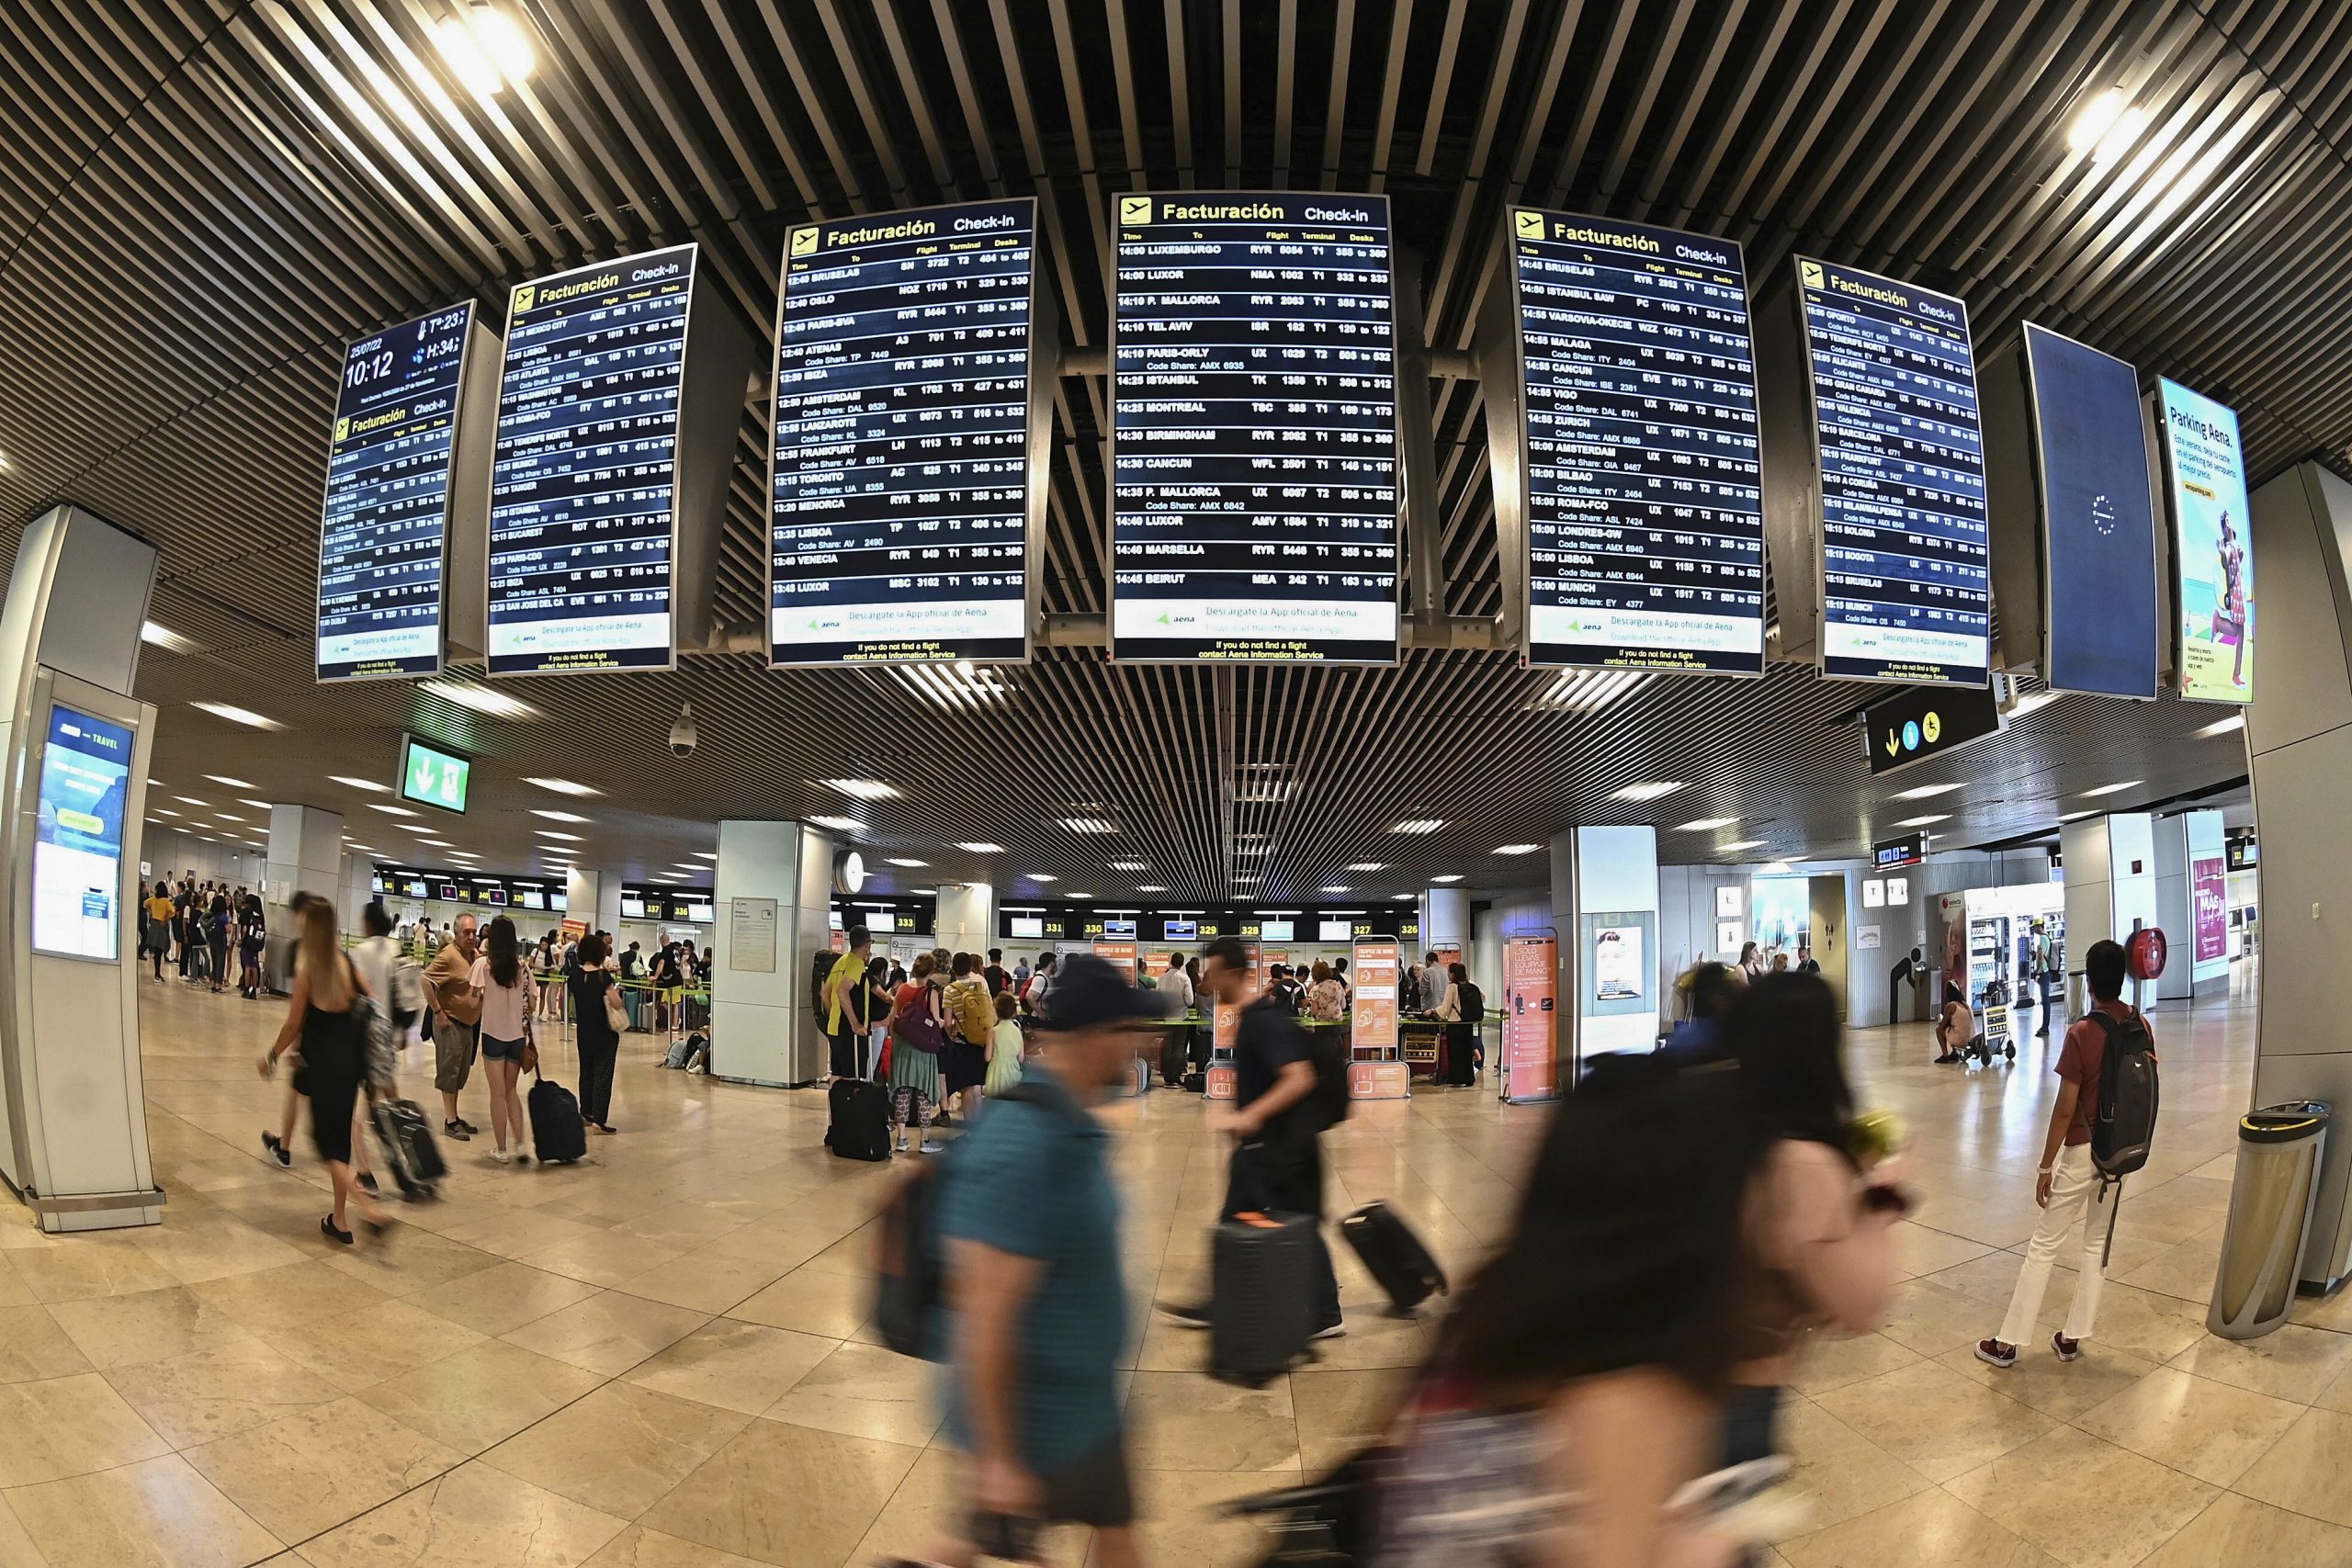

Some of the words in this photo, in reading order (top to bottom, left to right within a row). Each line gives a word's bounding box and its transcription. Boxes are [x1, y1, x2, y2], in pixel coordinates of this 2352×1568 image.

[1164, 204, 1283, 219] Facturación
[1305, 208, 1368, 221] Check-in
[828, 220, 935, 246] Facturación
[954, 215, 1014, 231] Check-in
[1266, 231, 1289, 240] Flight
[916, 246, 937, 254] Flight
[949, 242, 981, 250] Terminal
[1555, 223, 1659, 253] Facturación
[1676, 245, 1726, 265] Check-in
[1119, 246, 1145, 255] 14:00
[1148, 245, 1221, 254] LUXEMBURGO
[1250, 245, 1272, 254] RYR
[1312, 246, 1324, 255] T1
[1519, 259, 1543, 269] 14:45
[1545, 263, 1595, 276] BRUSELAS
[1521, 246, 1538, 254] Time
[1646, 264, 1665, 272] Flight
[1675, 268, 1702, 278] Terminal
[1713, 275, 1733, 284] Desks
[811, 268, 860, 282] BRUSELAS
[1119, 271, 1145, 280] 14:00
[1148, 270, 1183, 279] LUXOR
[1313, 271, 1324, 280] T1
[540, 275, 618, 303] Facturación
[632, 264, 678, 281] Check-in
[1547, 287, 1592, 300] ISTANBUL
[1594, 292, 1614, 302] SAW
[1830, 275, 1907, 308] Facturación
[1919, 302, 1955, 321] Check-in
[809, 295, 835, 306] OSLO
[1148, 296, 1156, 305] P.
[1161, 296, 1220, 305] MALLORCA
[1147, 321, 1167, 332] TEL
[1168, 321, 1193, 332] AVIV
[1339, 324, 1356, 333] 120
[1373, 325, 1390, 335] 122
[1549, 311, 1633, 330] VARSOVIA-OKECIE
[1664, 327, 1682, 337] 1472
[806, 343, 842, 355] ATENAS
[1010, 327, 1025, 336] 411
[1551, 337, 1591, 349] MALAGA
[350, 338, 382, 358] 25/07/22
[1147, 348, 1209, 357] PARIS-ORLY
[1251, 348, 1267, 357] UX
[1315, 349, 1328, 359] T2
[1619, 357, 1635, 367] 2404
[347, 351, 393, 388] 10:12
[521, 367, 549, 379] ATLANTA
[1552, 363, 1592, 375] CANCUN
[1147, 375, 1199, 385] ISTANBUL
[1374, 378, 1391, 389] 312
[802, 391, 861, 405] AMSTERDAM
[1007, 379, 1023, 389] 431
[1554, 389, 1577, 400] VIGO
[1147, 402, 1206, 412] MONTREAL
[1838, 405, 1871, 417] VALENCIA
[352, 408, 405, 434] Facturación
[414, 399, 447, 415] Check-in
[1622, 410, 1638, 418] 6741
[1555, 416, 1590, 427] ZURICH
[2170, 406, 2207, 440] Parking
[2209, 423, 2233, 448] Aena.
[1147, 430, 1216, 440] BIRMINGHAM
[1838, 429, 1882, 442] BARCELONA
[800, 445, 856, 457] FRANKFURT
[891, 441, 905, 450] LH
[921, 438, 941, 448] 1113
[1146, 458, 1192, 468] CANCUN
[1251, 458, 1275, 468] WFL
[799, 472, 844, 484] TORONTO
[1557, 470, 1593, 481] BILBAO
[1116, 488, 1143, 497] 14:35
[1160, 487, 1221, 496] MALLORCA
[1252, 488, 1268, 497] UX
[1317, 489, 1329, 498] T2
[798, 499, 845, 511] MENORCA
[1557, 498, 1609, 510] ROMA-FCO
[1146, 516, 1183, 525] LUXOR
[1252, 516, 1277, 525] AMV
[1376, 519, 1393, 528] 321
[1625, 517, 1643, 525] 7424
[1558, 525, 1622, 538] LONDRES-GW
[1146, 545, 1204, 554] MARSELLA
[797, 554, 838, 565] VENECIA
[1558, 554, 1594, 564] LISBOA
[797, 581, 830, 592] LUXOR
[1005, 575, 1023, 584] 132
[1115, 574, 1143, 583] 14:45
[1146, 574, 1185, 583] BEIRUT
[1288, 575, 1306, 584] 242
[1845, 577, 1882, 588] BRUSELAS
[1558, 582, 1596, 592] MUNICH
[1260, 607, 1268, 615] la
[1271, 607, 1287, 617] App
[1321, 608, 1331, 616] de
[1335, 609, 1357, 617] Aena
[1288, 642, 1306, 650] flight
[1199, 650, 1227, 659] contact
[1250, 650, 1294, 659] Information
[1295, 651, 1324, 660] Service
[93, 733, 118, 750] TRAVEL
[2200, 892, 2219, 911] MÁS
[674, 907, 688, 916] 336
[898, 919, 913, 928] 333
[1046, 923, 1062, 932] 331
[1085, 924, 1102, 933] 330
[1199, 925, 1217, 935] 329
[1241, 926, 1259, 935] 328
[1353, 925, 1371, 935] 327
[1401, 925, 1418, 934] 326
